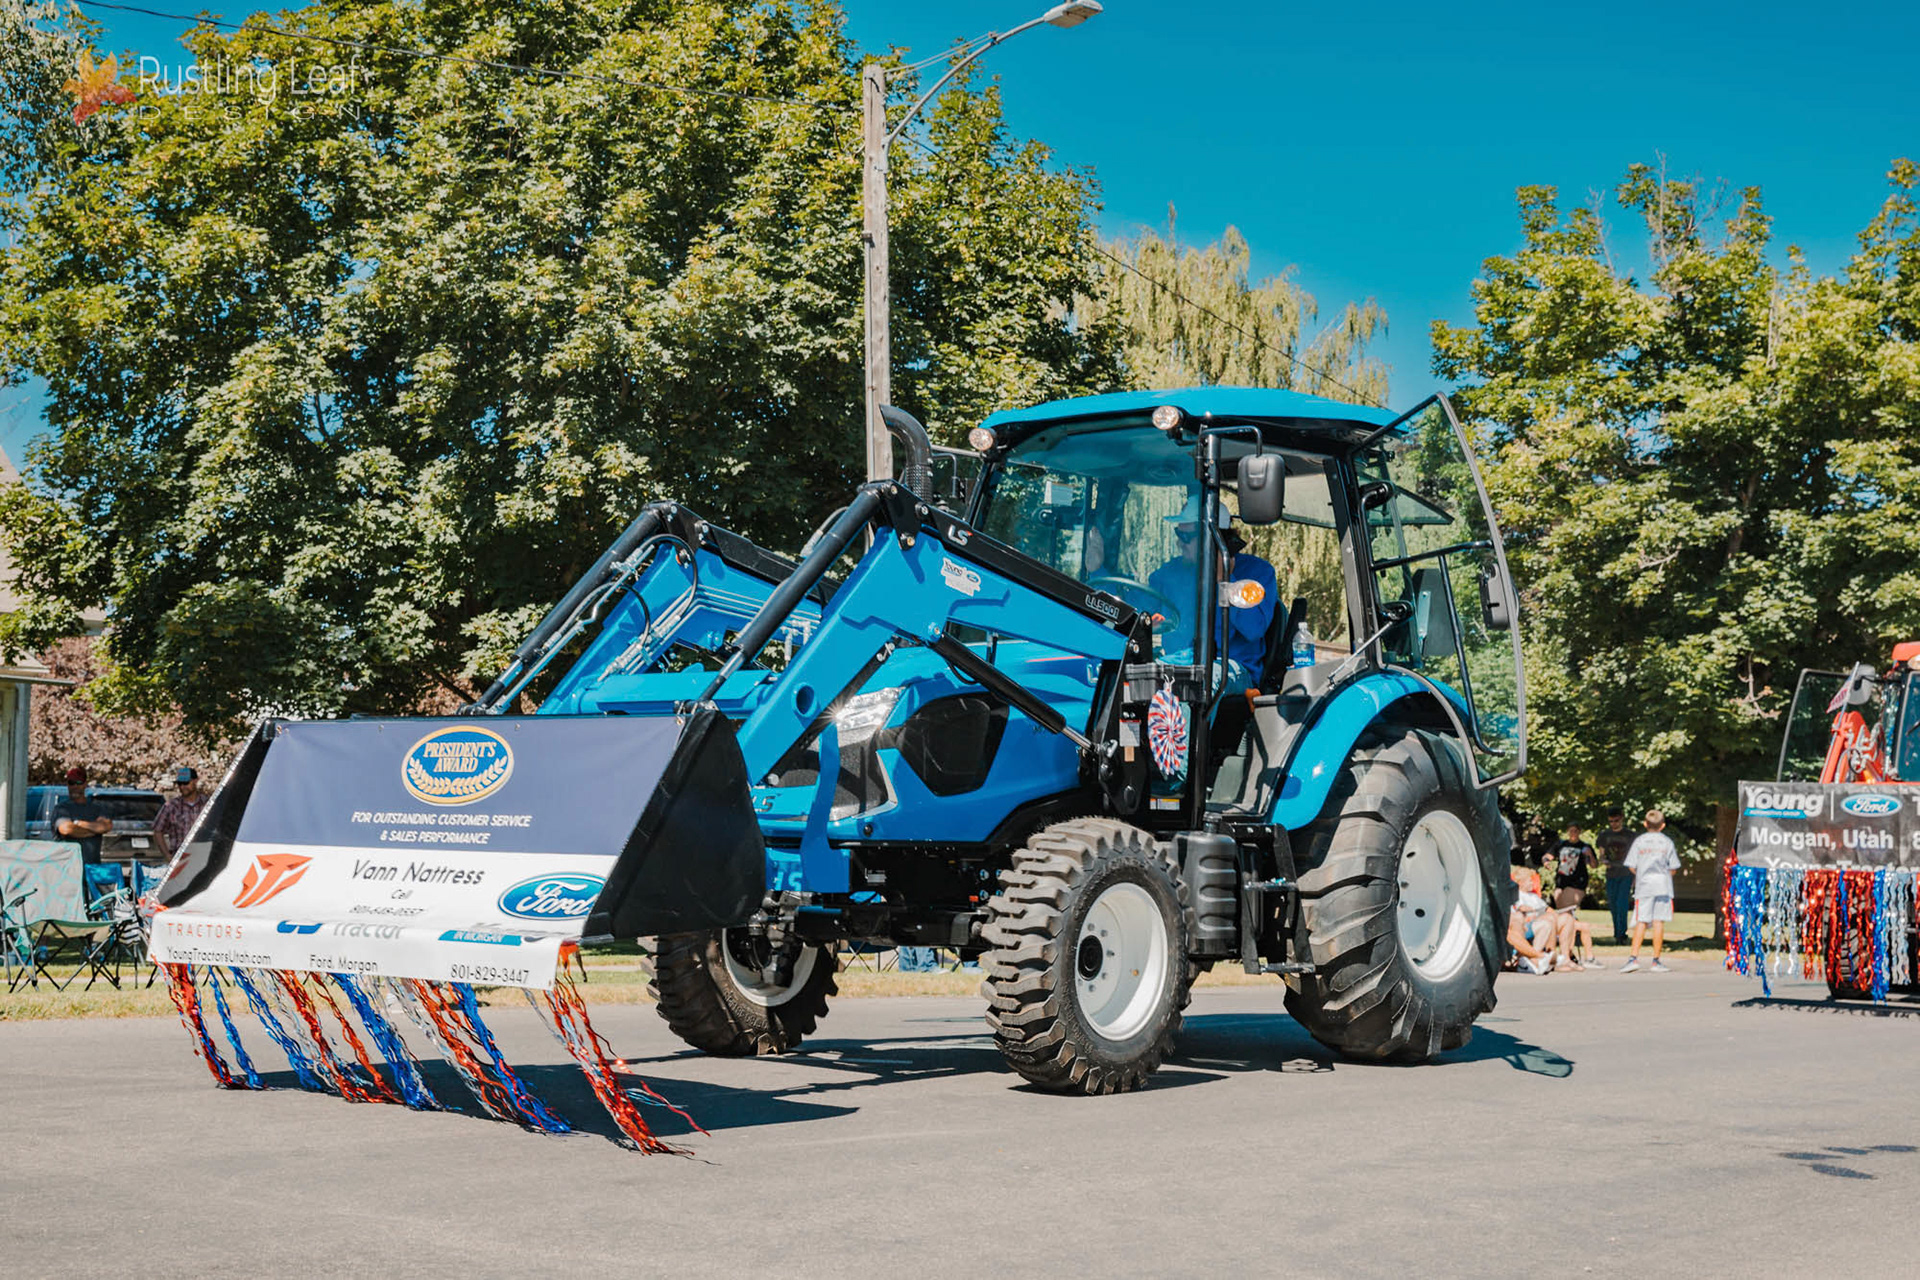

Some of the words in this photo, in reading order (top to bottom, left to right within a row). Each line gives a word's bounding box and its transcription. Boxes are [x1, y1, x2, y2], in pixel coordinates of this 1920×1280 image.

[948, 524, 968, 546] LS
[423, 742, 498, 758] PRESIDENT'S
[433, 757, 479, 773] AWARD
[1745, 785, 1825, 818] Young
[1852, 797, 1891, 814] Ford
[351, 811, 373, 823] FOR
[373, 812, 438, 826] OUTSTANDING
[438, 814, 489, 827] CUSTOMER
[490, 815, 533, 828] SERVICE
[379, 830, 388, 842] &
[388, 831, 418, 843] SALES
[417, 832, 491, 845] PERFORMANCE
[1750, 826, 1837, 851] Morgan,
[1842, 829, 1895, 850] Utah
[352, 859, 399, 880] Vann
[402, 861, 486, 885] Nattress
[516, 880, 600, 916] Ford
[167, 922, 244, 940] TRACTORS
[167, 946, 272, 966] YoungTractorsUtah.com
[339, 956, 379, 974] Morgan
[450, 963, 530, 985] 801-829-3447
